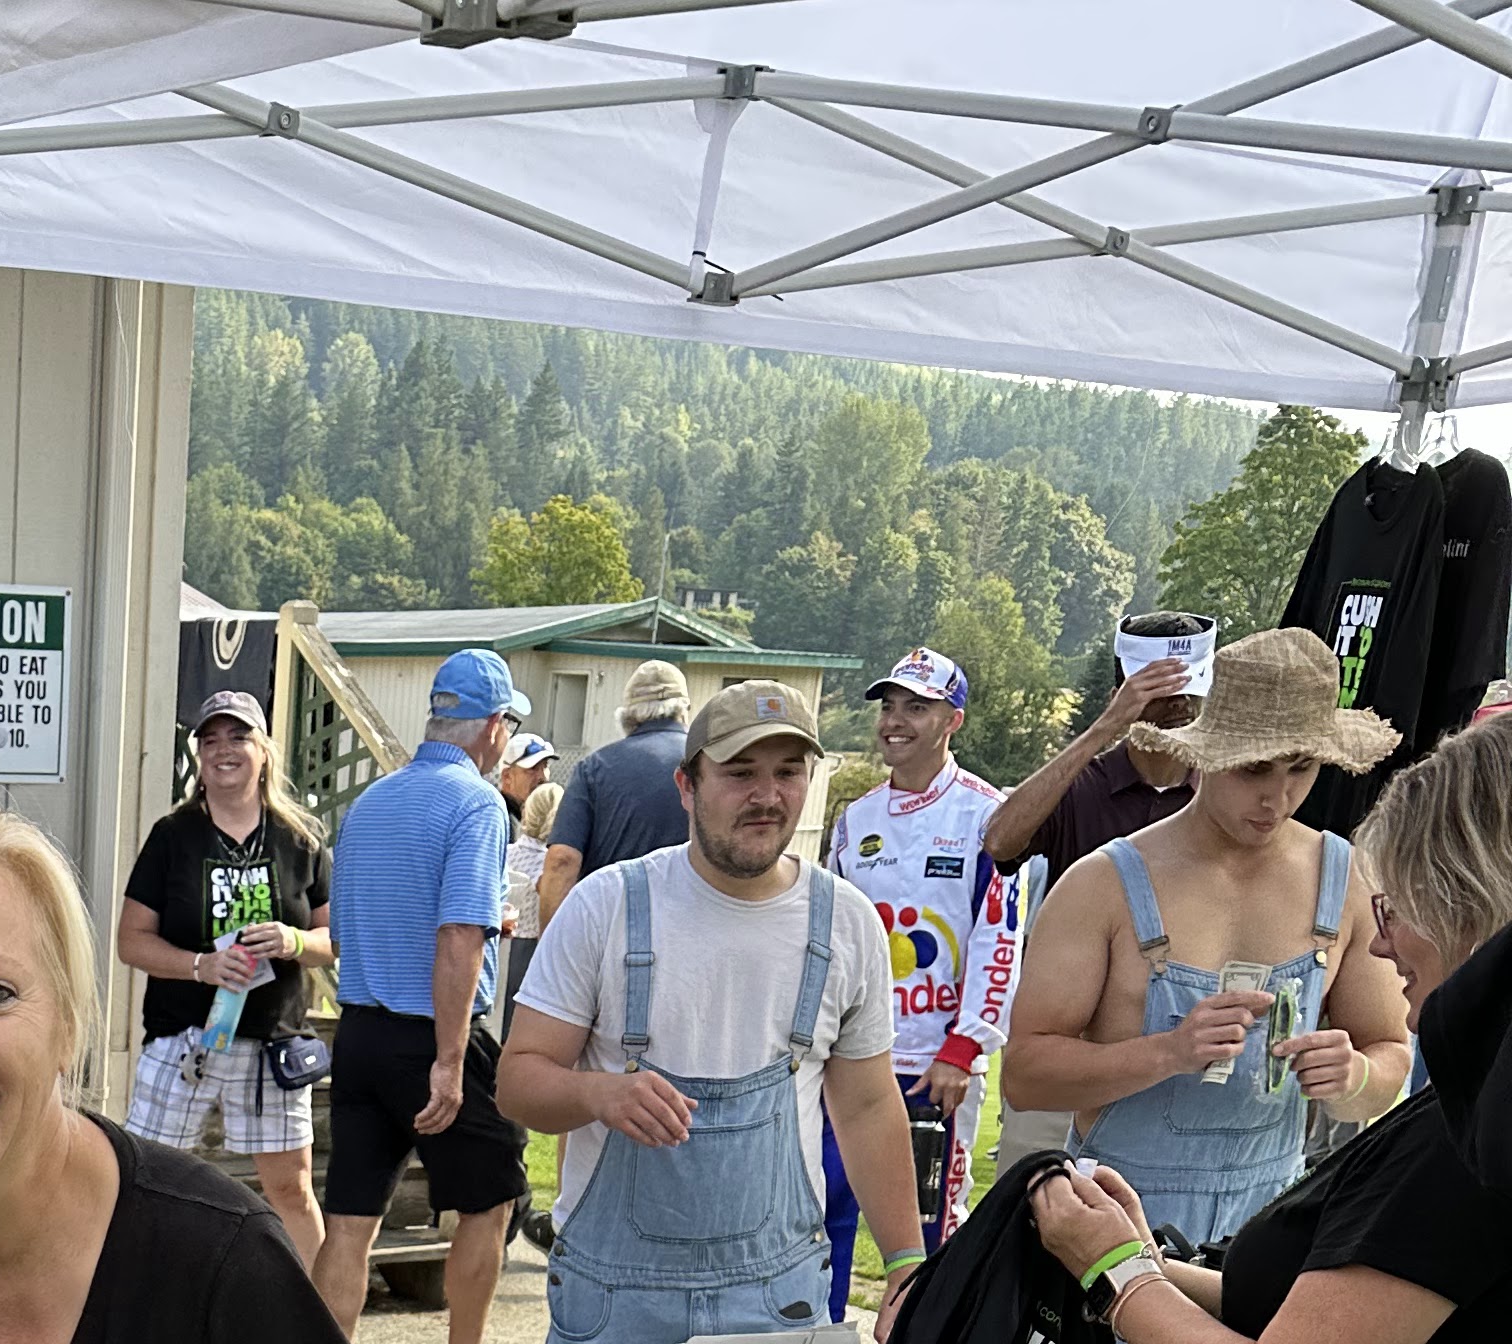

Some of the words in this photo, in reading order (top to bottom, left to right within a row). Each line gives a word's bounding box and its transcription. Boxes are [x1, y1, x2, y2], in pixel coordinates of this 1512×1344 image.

[19, 656, 48, 675] EAT
[1342, 657, 1366, 689] TE
[14, 680, 47, 700] YOU
[33, 705, 51, 724] TO
[980, 932, 1016, 1025] onder
[894, 974, 959, 1017] nde
[945, 1139, 966, 1239] onder
